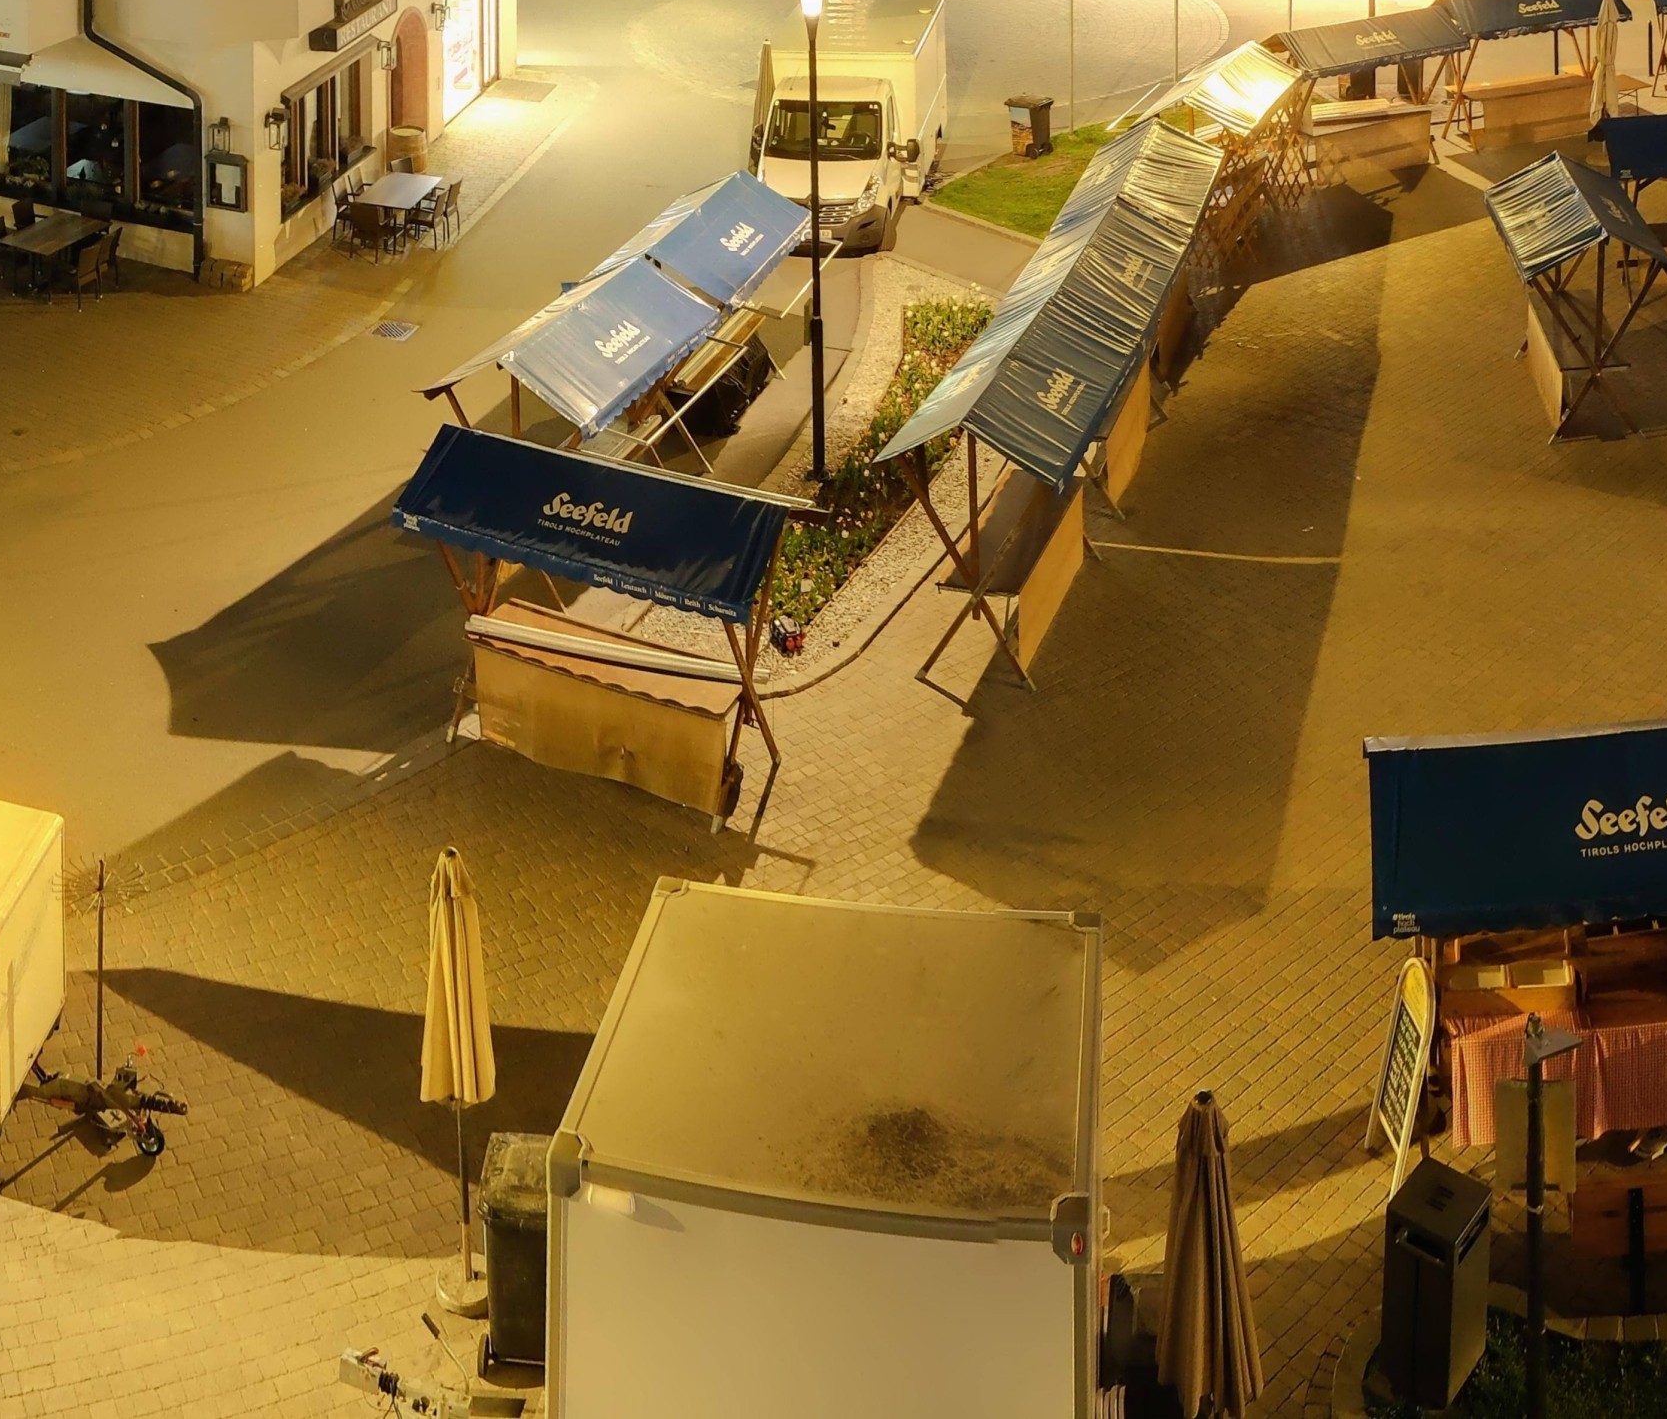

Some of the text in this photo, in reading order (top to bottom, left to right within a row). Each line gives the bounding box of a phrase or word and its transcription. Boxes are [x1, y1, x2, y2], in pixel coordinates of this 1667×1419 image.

[1355, 29, 1397, 47] Seefeld
[719, 221, 755, 252] Seefeld
[594, 319, 641, 359] Seefeld
[1037, 367, 1075, 412] Seefeld
[542, 492, 634, 534] Seefeld
[537, 518, 621, 547] TIROLS HOCHPLATEAU
[1579, 843, 1622, 859] TIROLS
